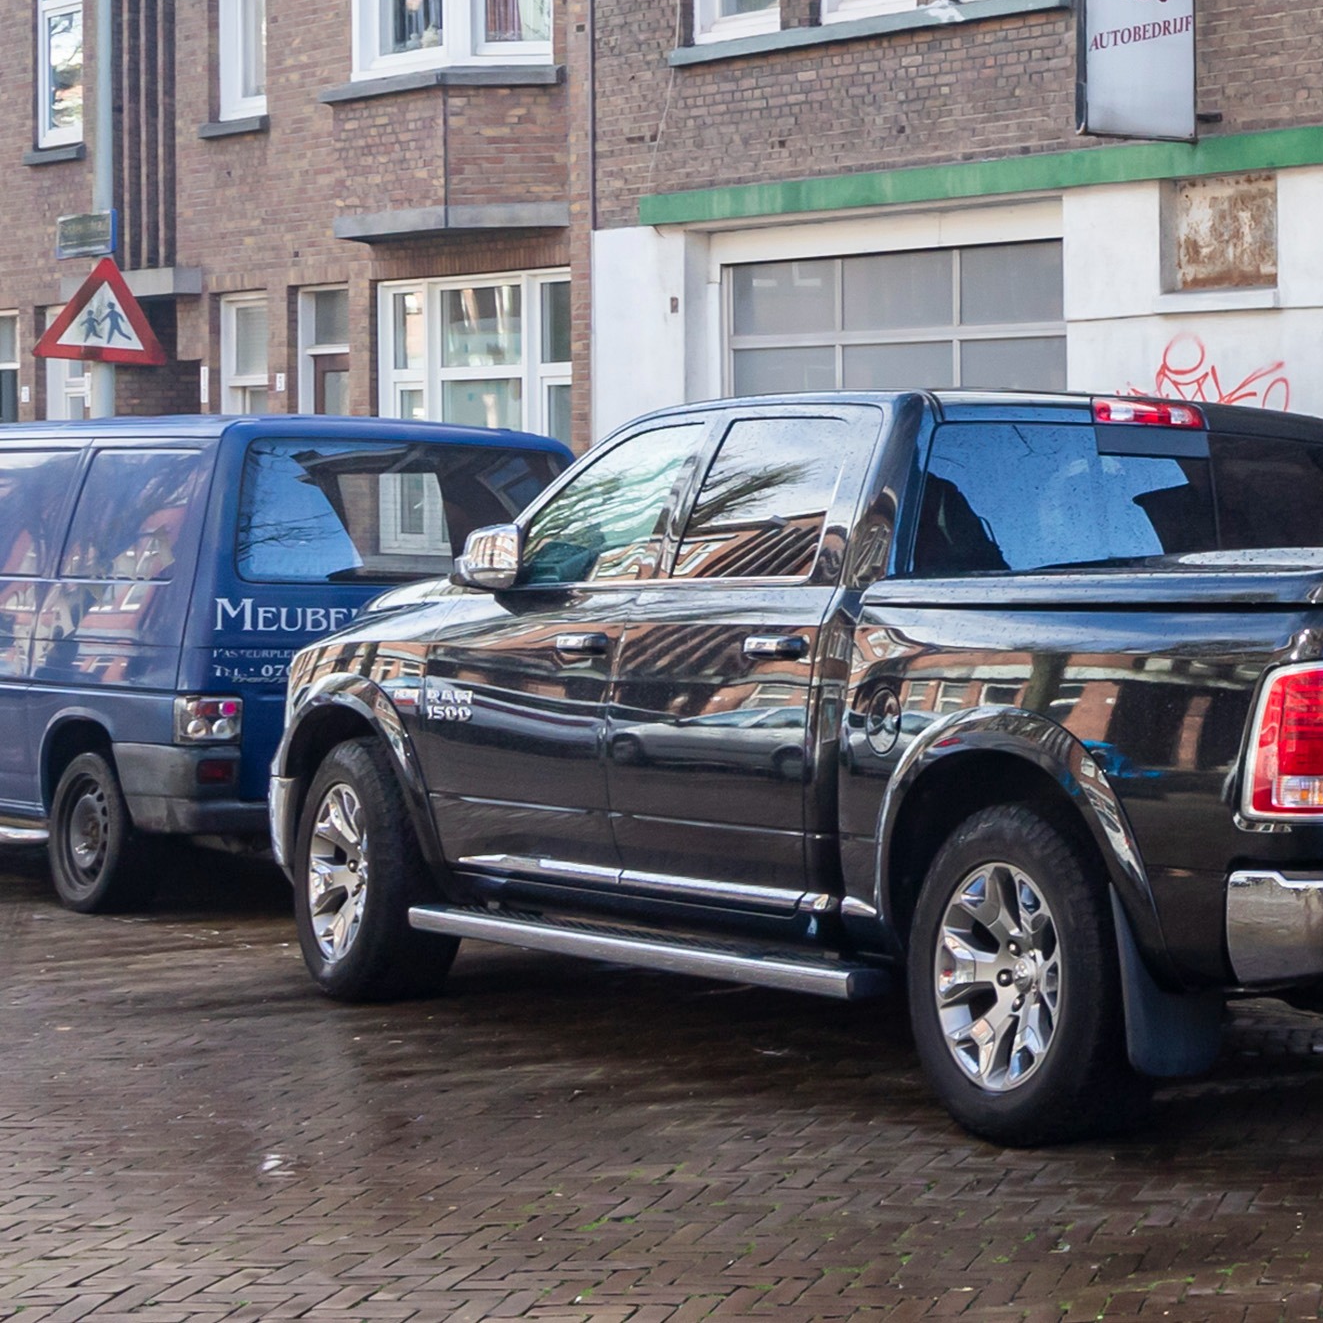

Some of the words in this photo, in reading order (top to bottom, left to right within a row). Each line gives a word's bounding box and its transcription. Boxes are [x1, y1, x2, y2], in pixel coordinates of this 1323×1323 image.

[1088, 14, 1193, 52] AUTOBEDRIJF
[426, 689, 474, 705] RAM
[426, 705, 473, 721] 1500
